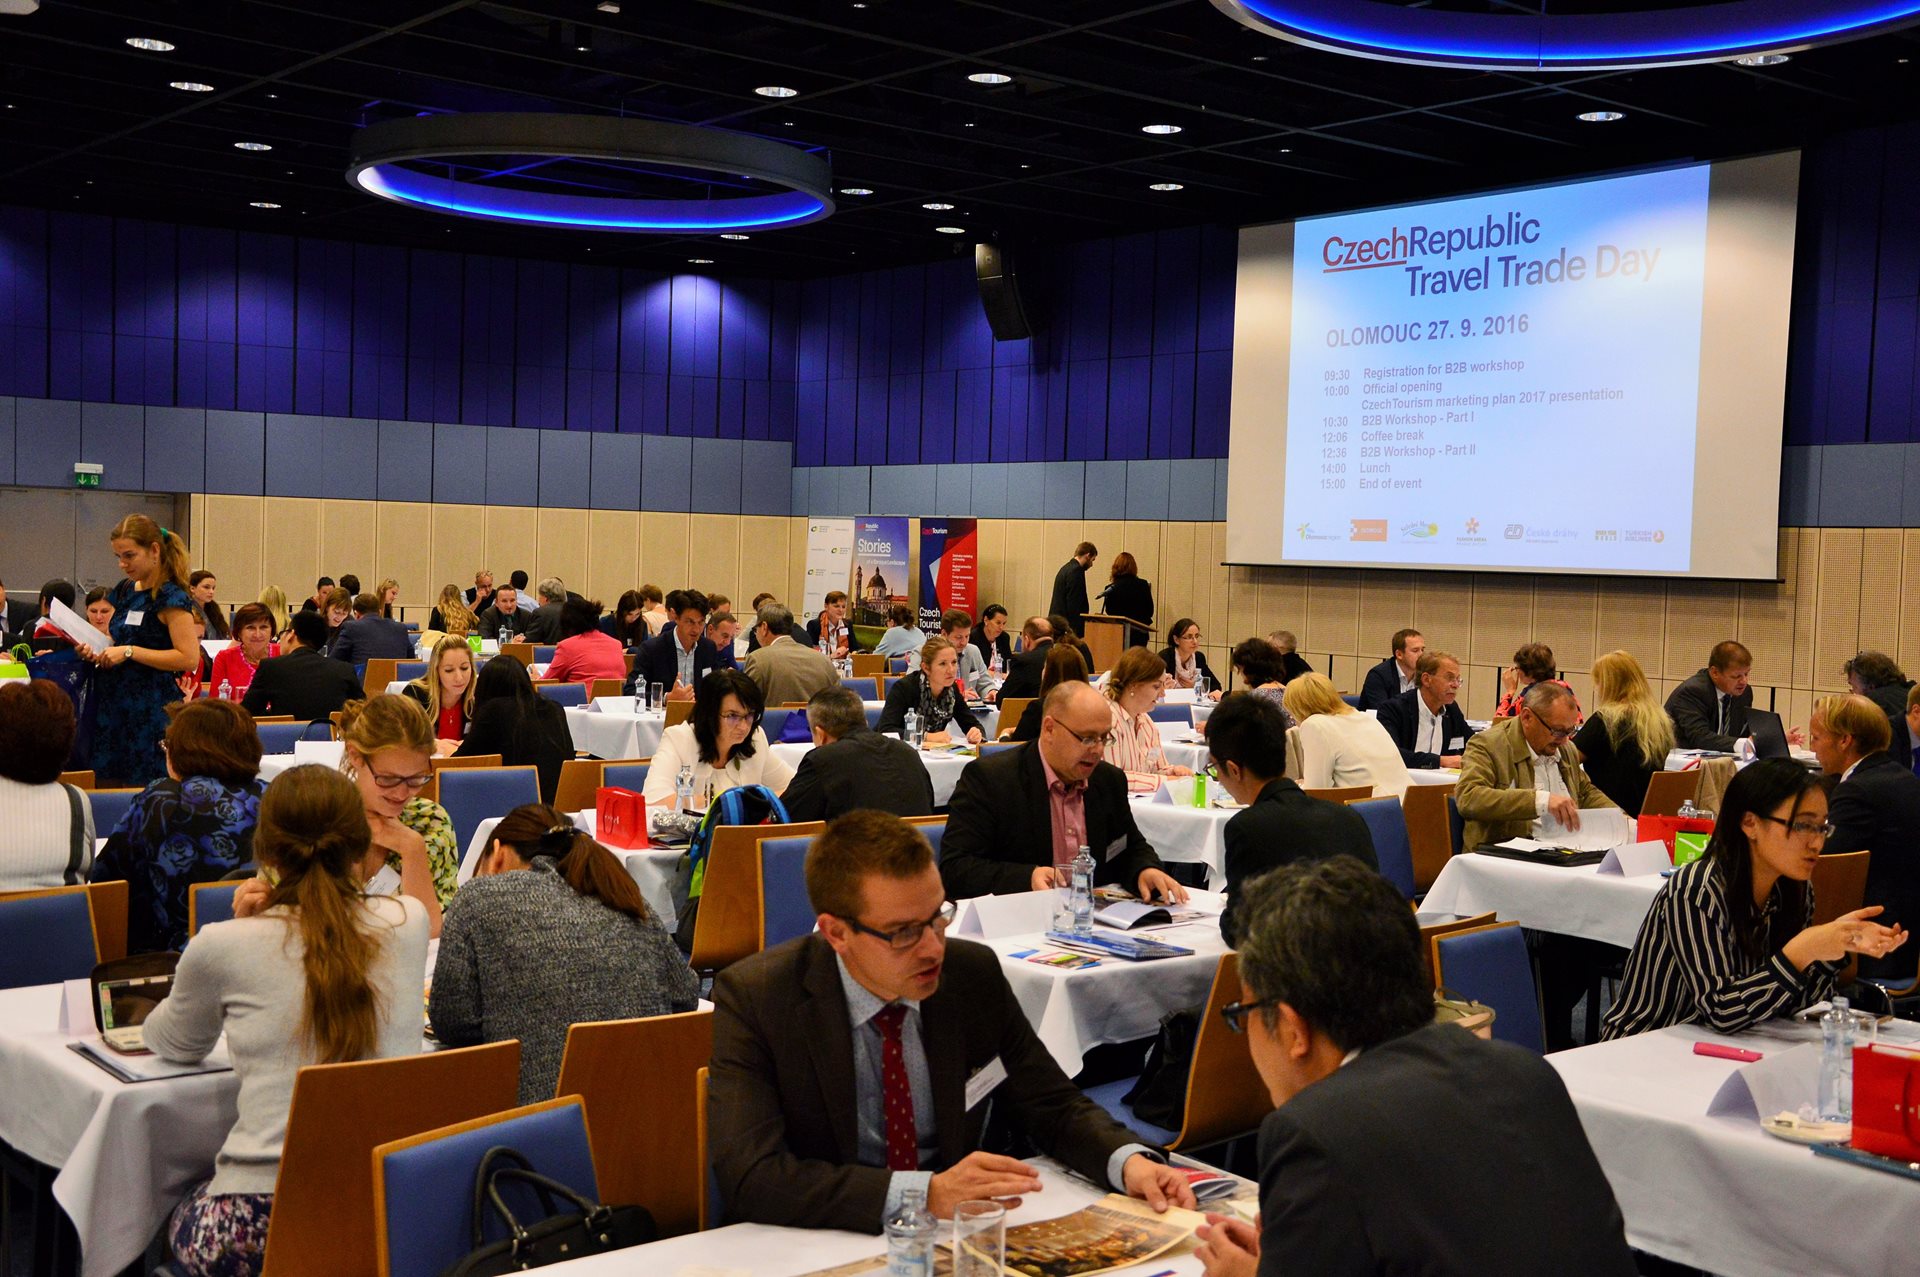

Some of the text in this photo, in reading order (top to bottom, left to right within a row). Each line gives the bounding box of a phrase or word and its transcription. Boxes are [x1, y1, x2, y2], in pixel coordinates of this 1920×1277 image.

[1404, 243, 1662, 298] Travel Trade Day
[1326, 314, 1529, 348] OLOMOUC 27. 9. 2016
[1324, 359, 1525, 381] 09:30 Registration for B2B workshop
[1323, 380, 1443, 397] 10:00 Official opening
[1435, 394, 1489, 410] marketing
[1492, 392, 1516, 407] plan
[1519, 391, 1545, 404] 2017
[1549, 387, 1624, 406] presentation
[1322, 416, 1348, 427] 10:30
[1362, 415, 1382, 426] B2B
[1384, 412, 1437, 427] Workshop
[1447, 411, 1468, 424] Part
[1322, 429, 1425, 443] 12:06 Coffee break
[1360, 446, 1381, 458] B2B
[1383, 445, 1437, 460] Workshop
[1445, 444, 1468, 456] Part
[1320, 462, 1391, 474] 14:00 Lunch
[1320, 478, 1422, 490] 15:00 End of event
[858, 538, 891, 554] Stories
[919, 606, 941, 618] Czech
[919, 618, 942, 630] Tourist
